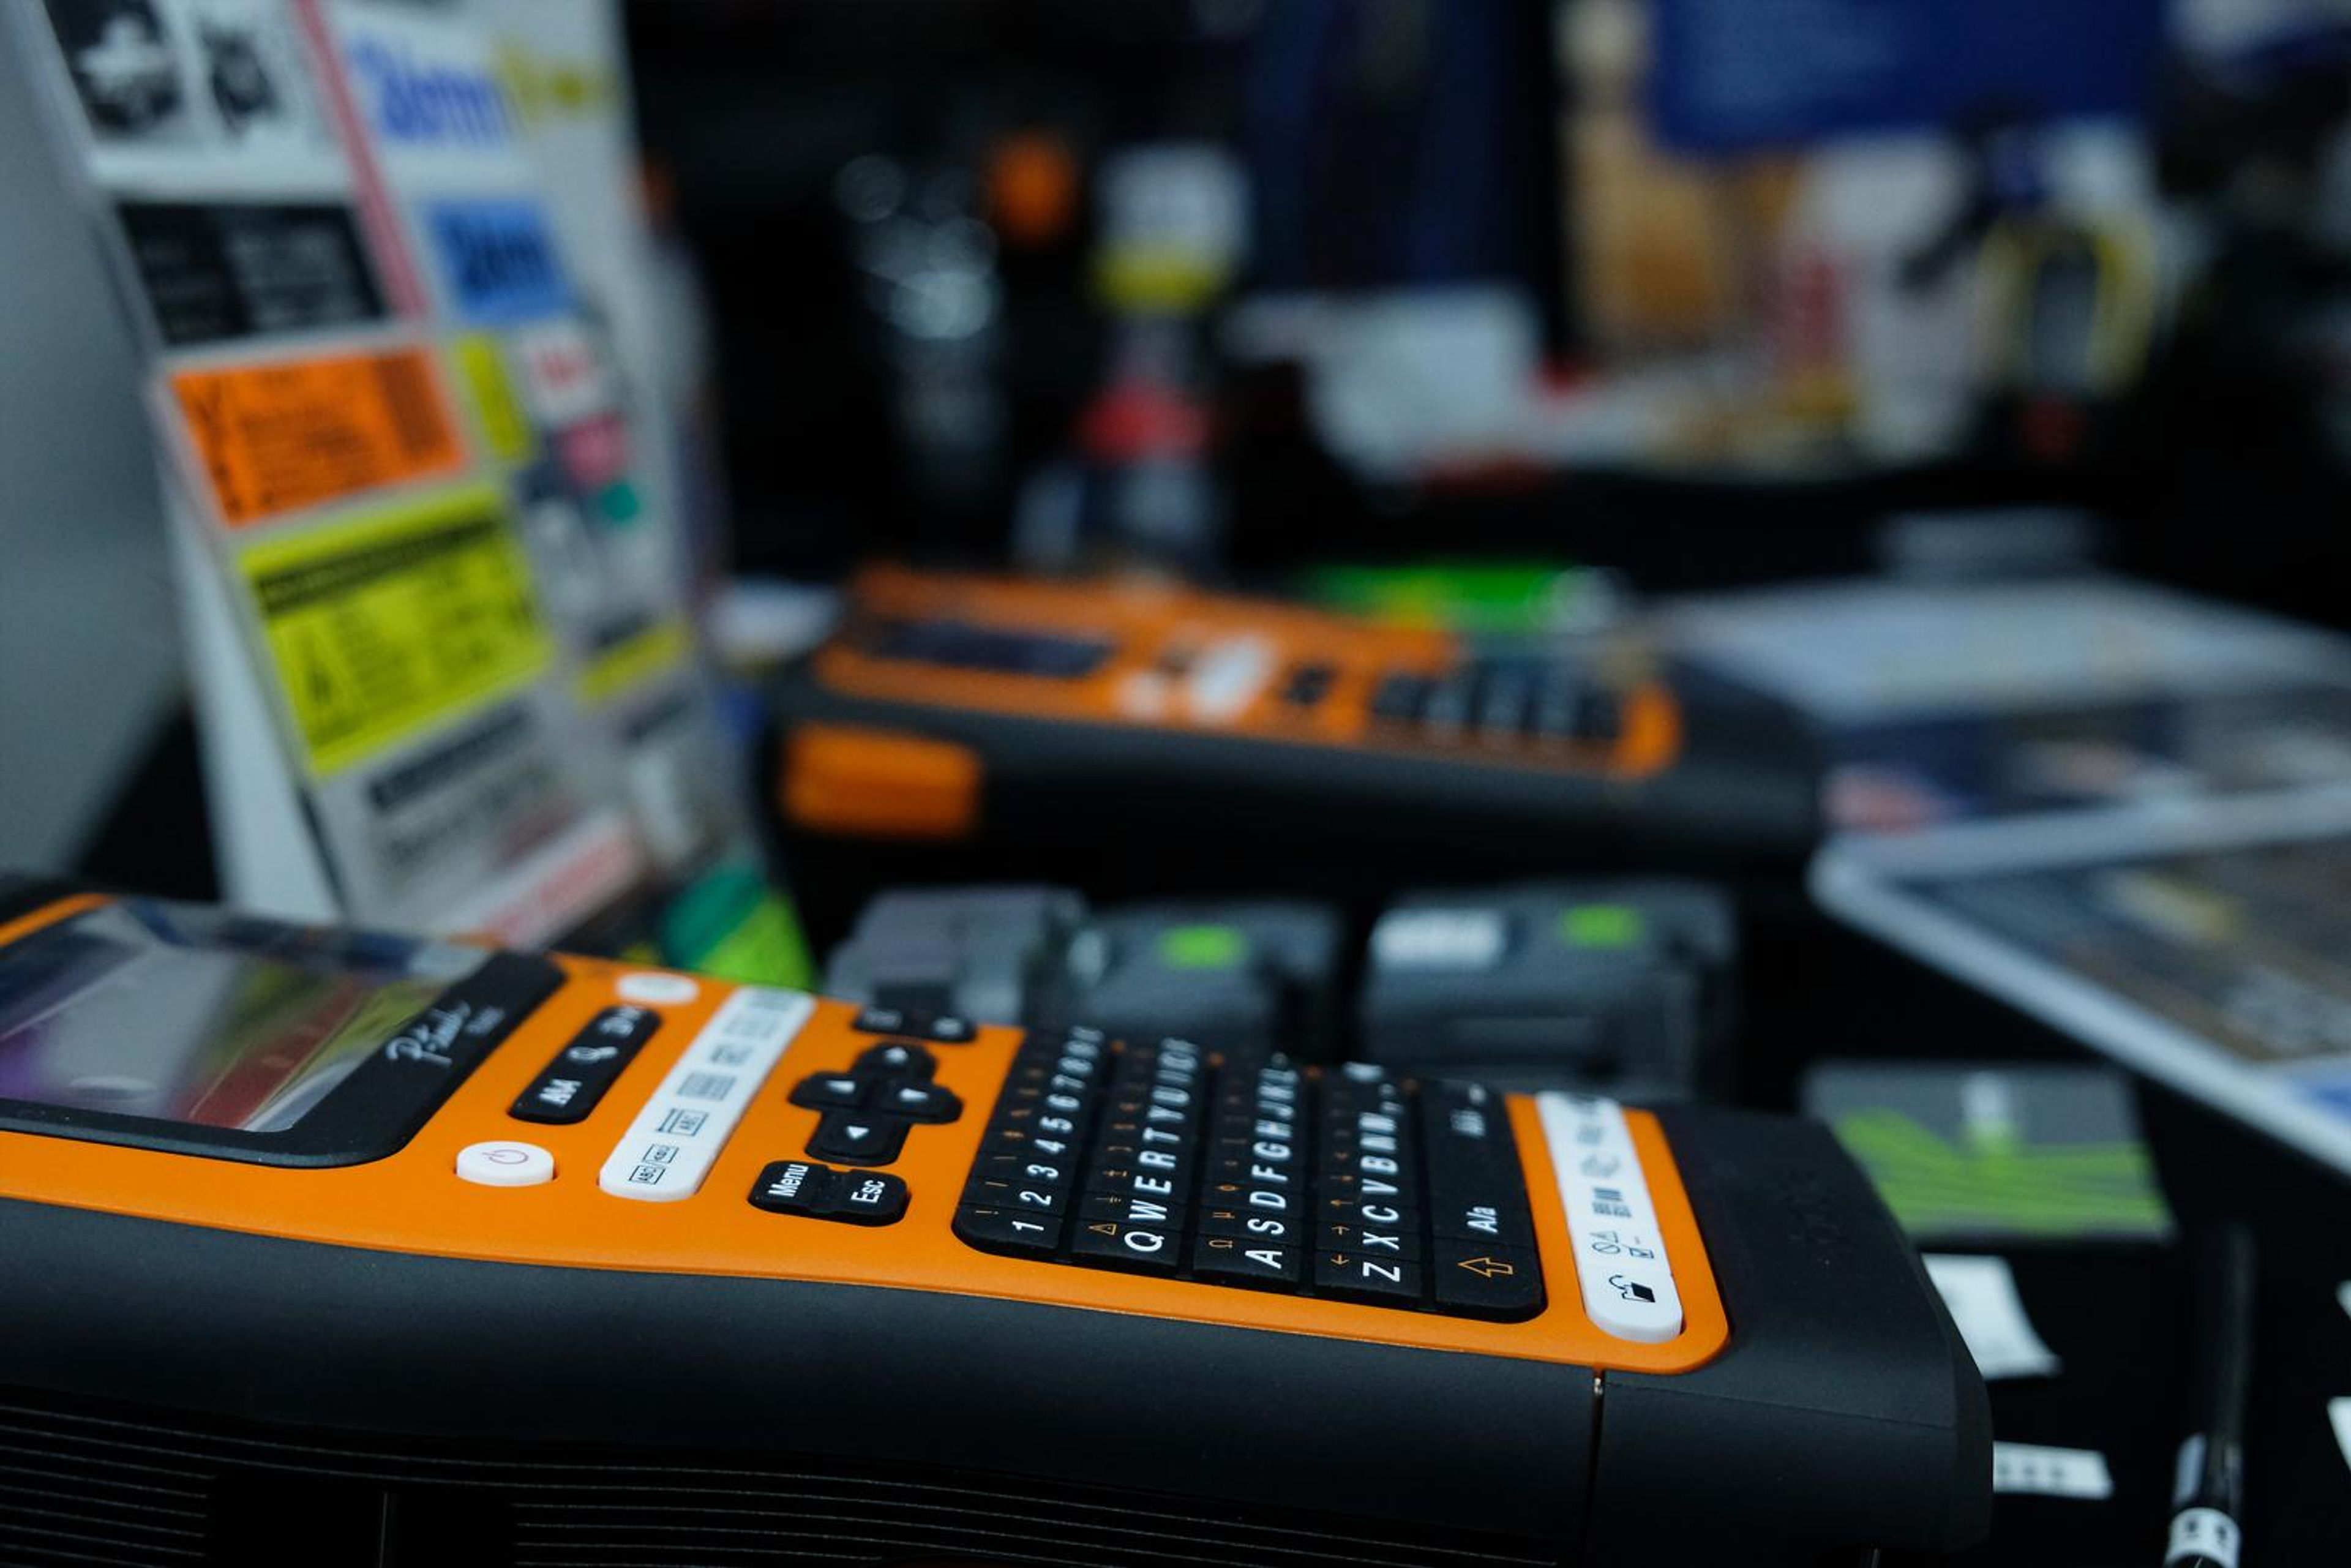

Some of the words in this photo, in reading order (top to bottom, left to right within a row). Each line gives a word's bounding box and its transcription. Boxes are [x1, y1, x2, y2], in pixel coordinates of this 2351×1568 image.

[1051, 1074, 1086, 1090] 7
[1046, 1093, 1081, 1111] 6
[1147, 1105, 1185, 1123] Y
[1040, 1116, 1073, 1132] 5
[1142, 1127, 1180, 1142] T
[1034, 1139, 1067, 1153] 4
[1253, 1141, 1291, 1160] G
[1138, 1150, 1177, 1169] R
[1360, 1155, 1399, 1176] B
[768, 1163, 809, 1198] Menu
[1027, 1165, 1059, 1179] 3
[1251, 1164, 1288, 1182] F
[850, 1179, 885, 1203] Esc
[1134, 1175, 1172, 1194] E
[1362, 1178, 1399, 1194] V
[1019, 1191, 1052, 1206] 2
[1249, 1191, 1286, 1209] D
[1128, 1198, 1168, 1220] W
[1362, 1204, 1399, 1221] C
[1012, 1221, 1044, 1231] 1
[1247, 1218, 1284, 1235] S
[1124, 1231, 1164, 1252] Q
[1362, 1231, 1400, 1250] X
[1245, 1250, 1283, 1269] A
[1363, 1262, 1400, 1282] Z
